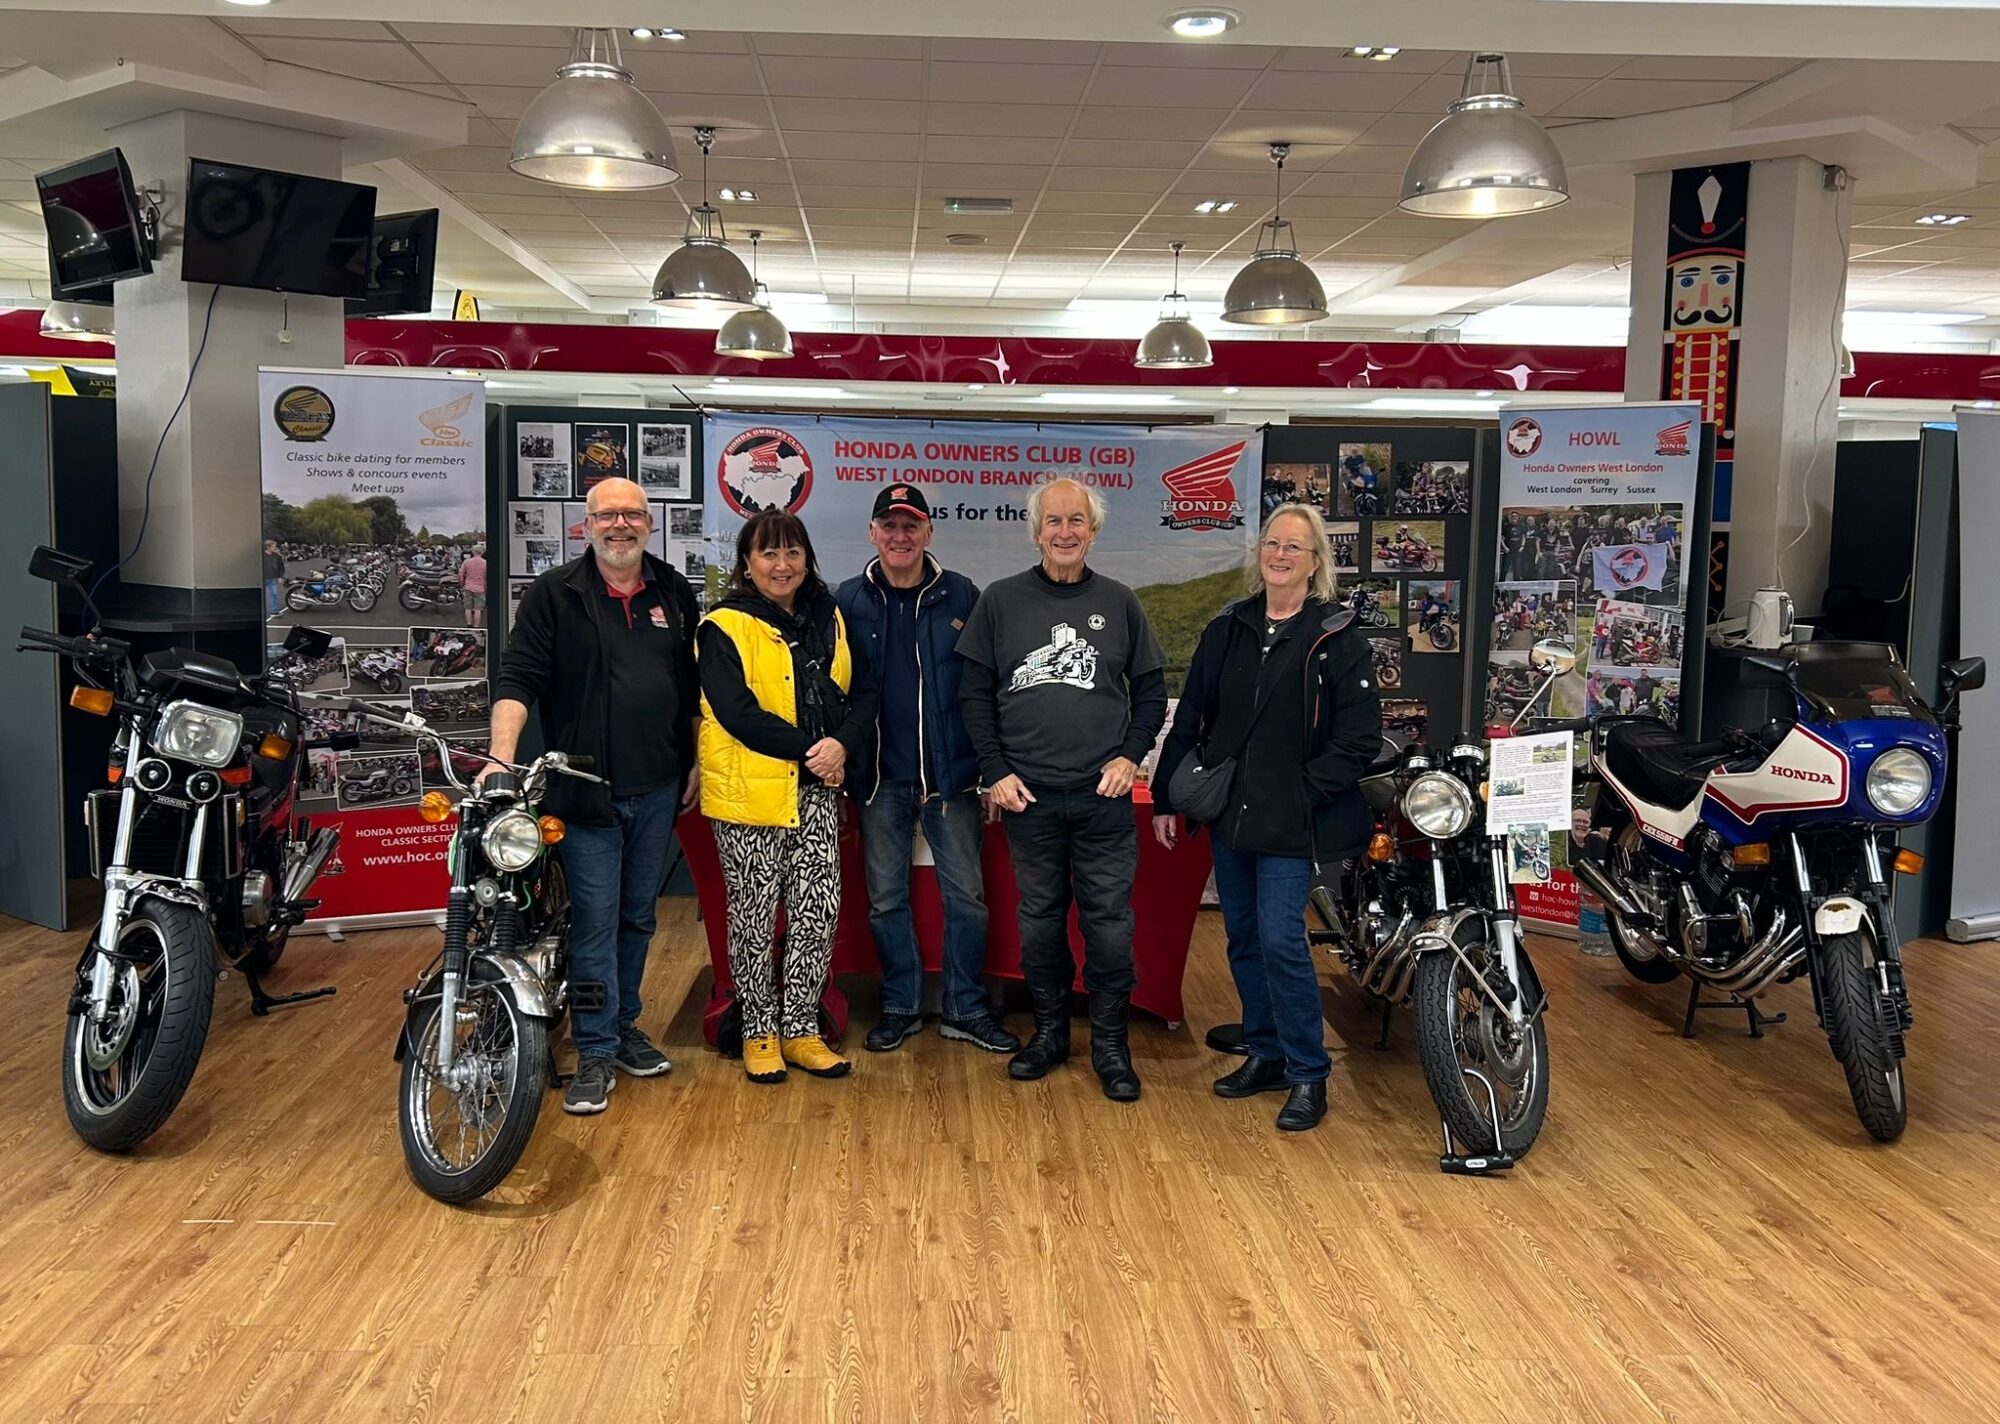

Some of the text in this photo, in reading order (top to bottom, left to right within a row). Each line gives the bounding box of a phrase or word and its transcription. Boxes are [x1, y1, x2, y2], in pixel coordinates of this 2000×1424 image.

[420, 438, 474, 448] Classic
[726, 428, 805, 455] HONDA OWNERS CLUB
[1568, 431, 1621, 447] HOWL
[286, 451, 466, 466] Classic bike dating for members
[834, 440, 1136, 468] HONDA OWNERS CLUB (GB)
[306, 467, 448, 480] Shows & concours events
[1523, 462, 1664, 473] Honda Owners West London
[835, 466, 887, 482] WEST
[892, 467, 974, 485] LONDON
[1573, 476, 1610, 486] covering
[351, 483, 405, 495] Meet ups
[1527, 485, 1656, 496] West London Surrey Sussex
[955, 502, 989, 521] for
[1161, 500, 1243, 512] HONDA
[1770, 765, 1836, 785] HONDA
[156, 796, 188, 808] HONDA
[356, 823, 458, 838] HONDA OWNERS CLU
[381, 837, 419, 847] CLASSIC
[363, 851, 449, 866] www.hoc.or
[1547, 878, 1567, 892] for
[1570, 882, 1581, 894] th
